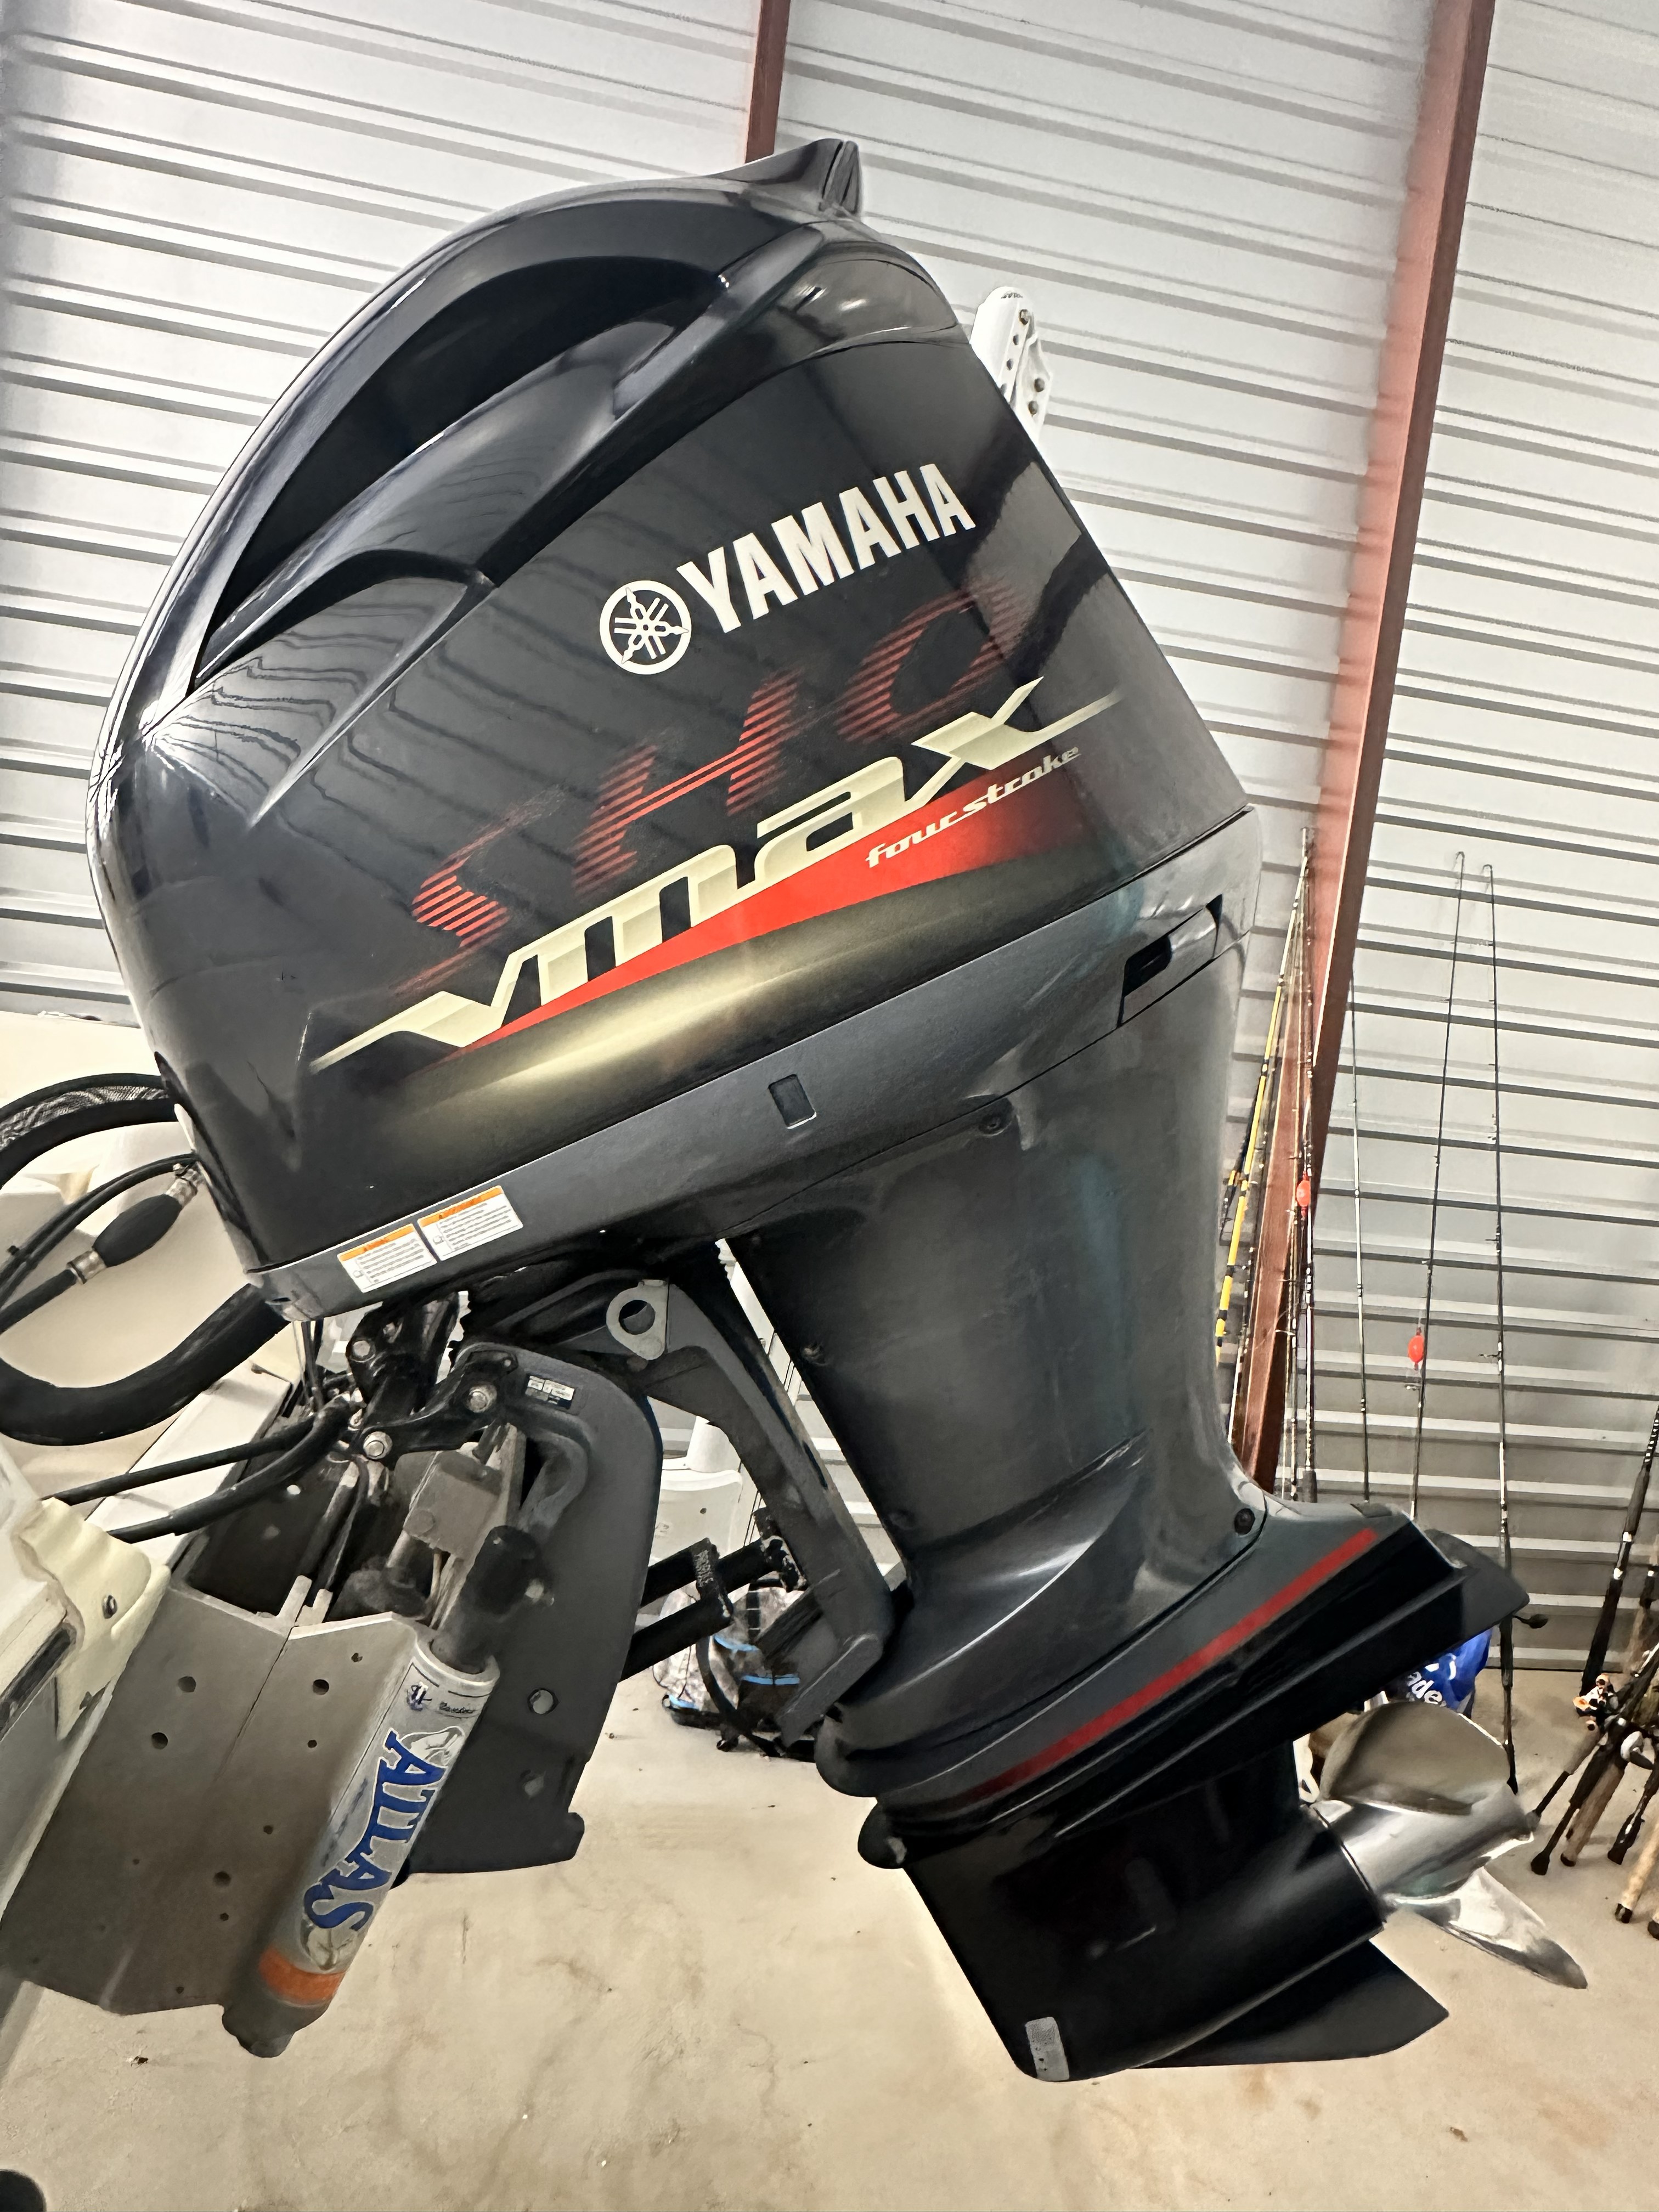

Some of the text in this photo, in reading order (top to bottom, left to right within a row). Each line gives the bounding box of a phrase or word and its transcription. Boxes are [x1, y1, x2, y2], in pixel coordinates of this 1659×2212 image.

[676, 463, 976, 634] YAMAHA
[865, 746, 1082, 868] fourstroke
[303, 1728, 448, 1931] ATLAS
